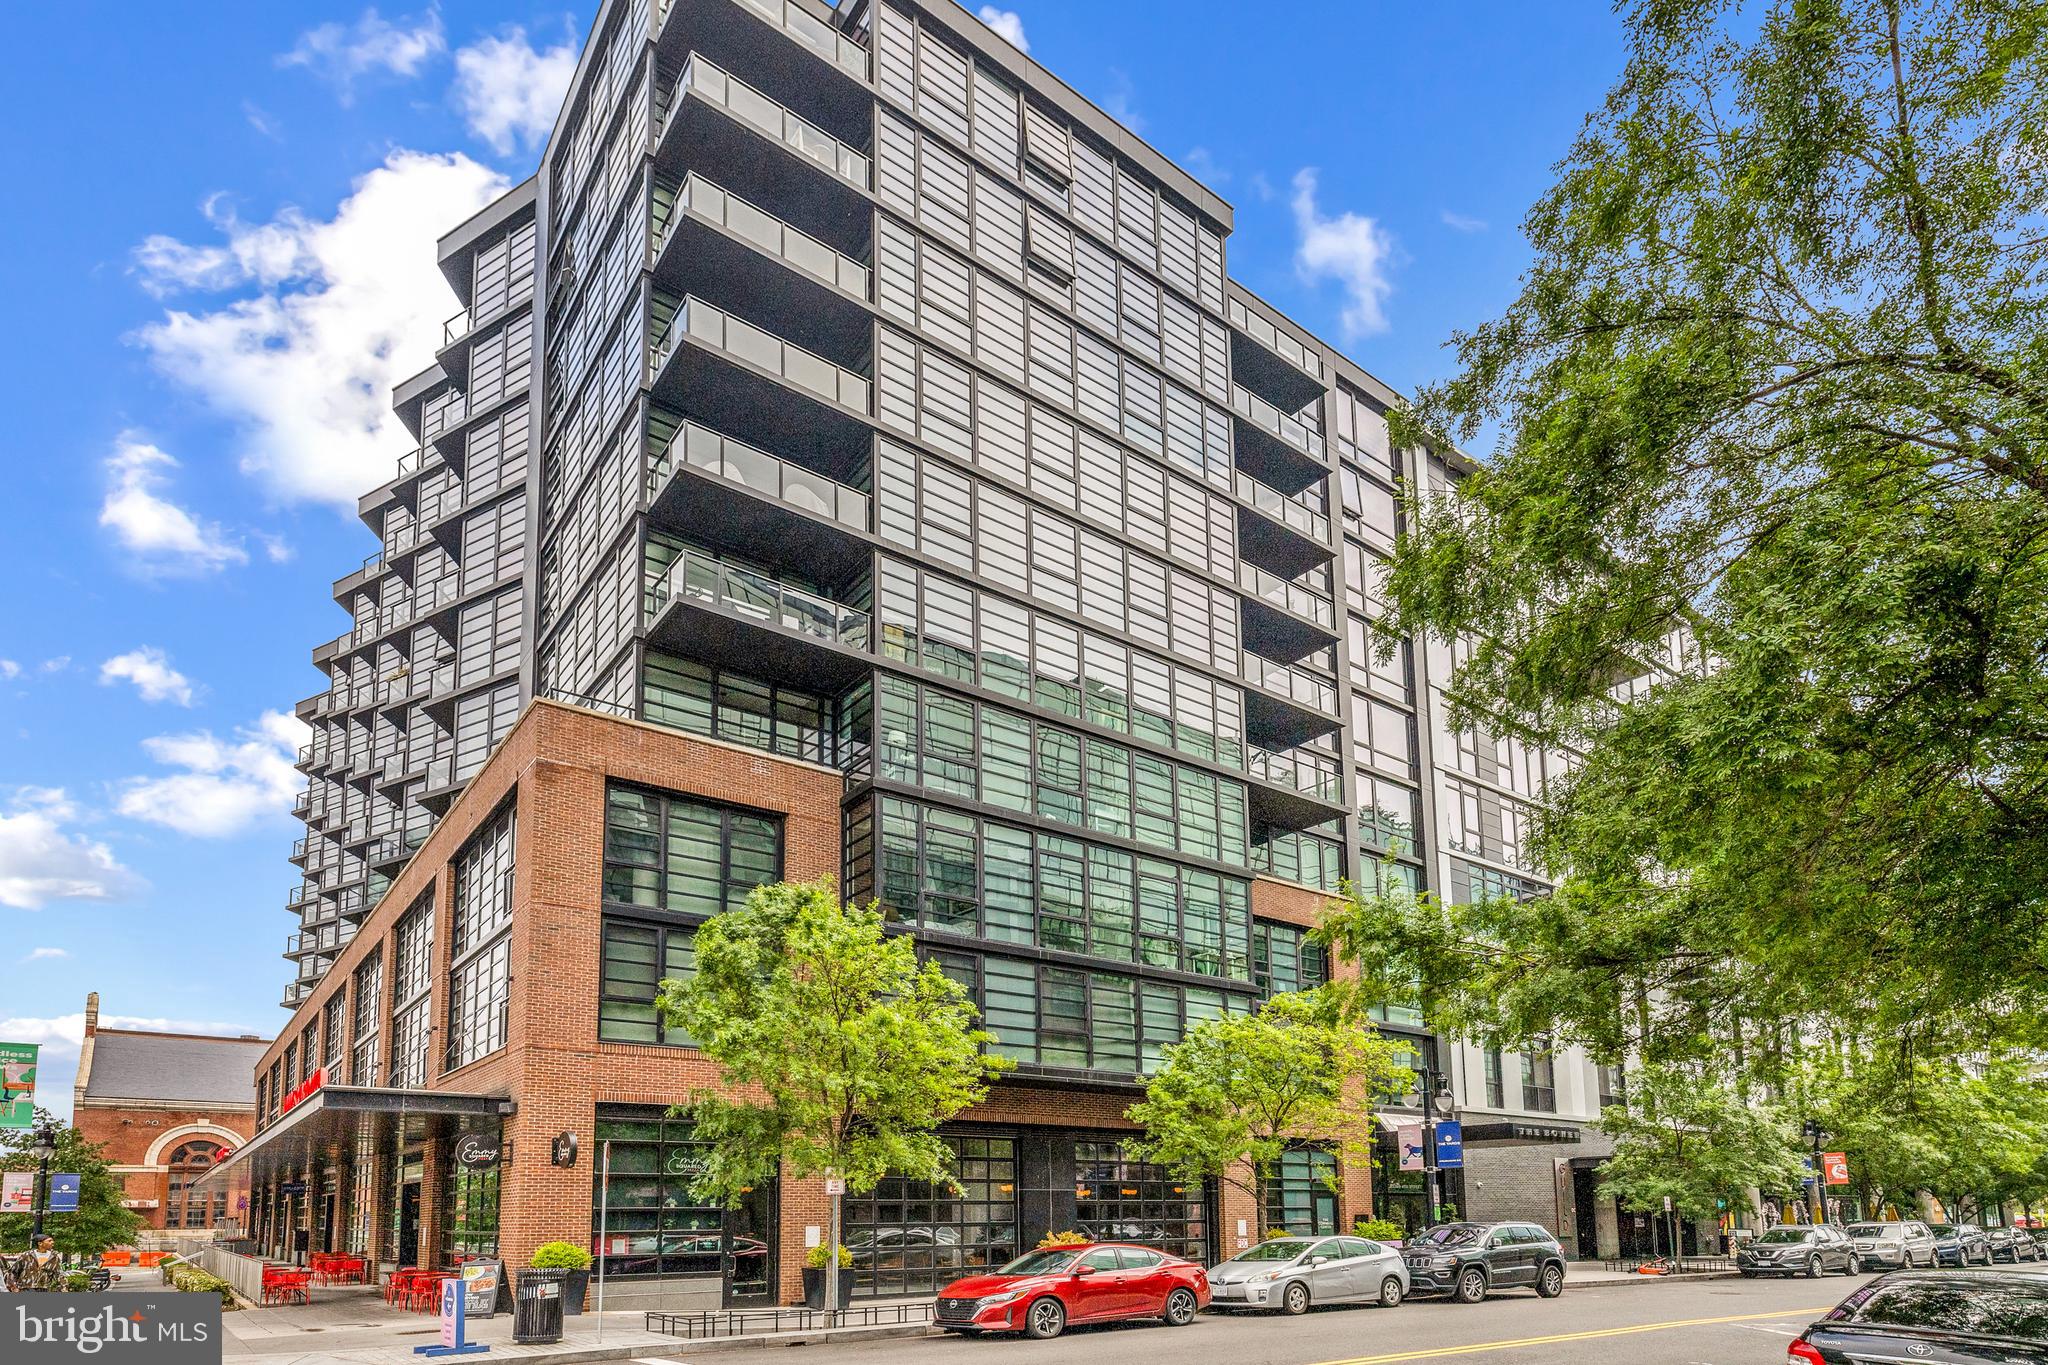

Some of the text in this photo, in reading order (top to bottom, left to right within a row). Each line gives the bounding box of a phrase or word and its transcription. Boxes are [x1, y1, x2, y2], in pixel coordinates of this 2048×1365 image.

[462, 1141, 499, 1163] Emmy
[667, 1147, 709, 1174] Emmy
[1559, 1163, 1569, 1231] GUILD
